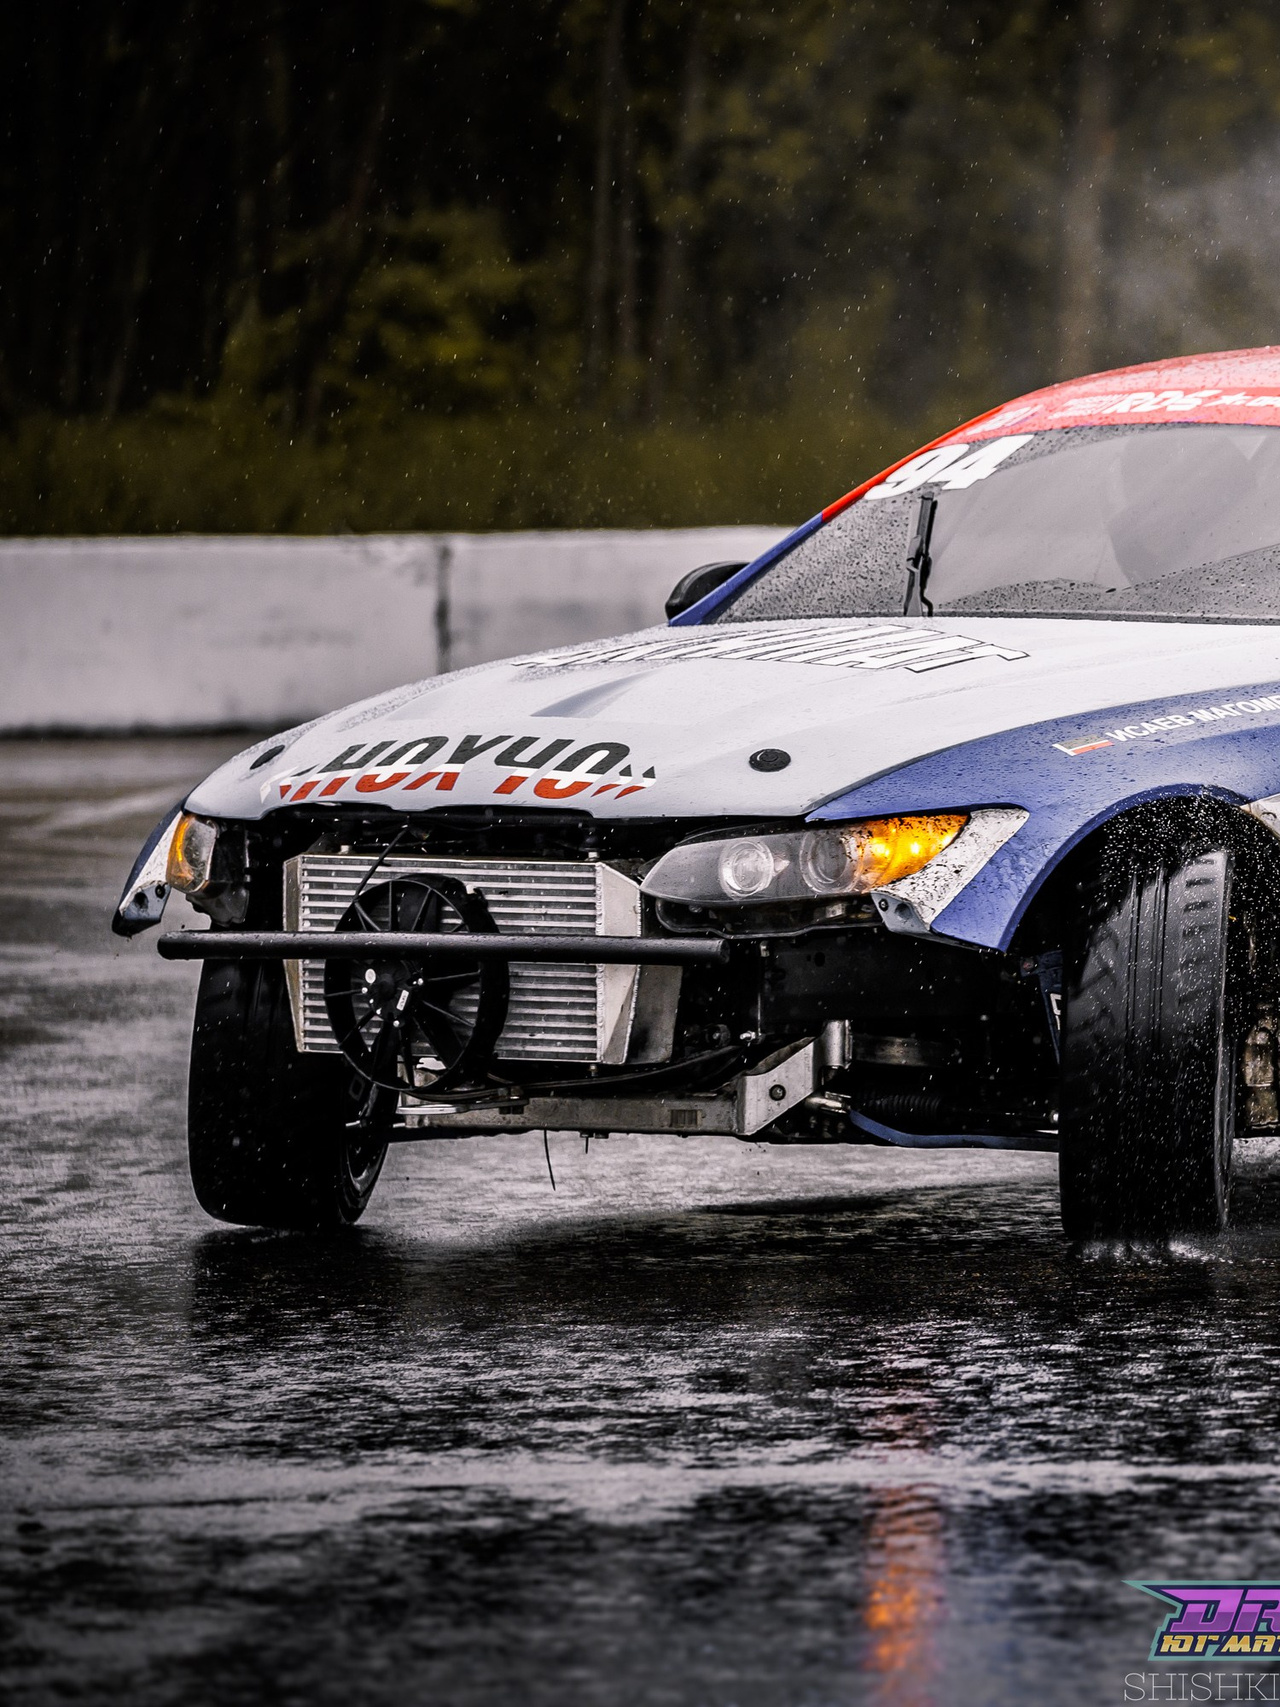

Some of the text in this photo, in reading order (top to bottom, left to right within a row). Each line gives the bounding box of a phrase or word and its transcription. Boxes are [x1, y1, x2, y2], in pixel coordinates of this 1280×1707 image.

[1103, 390, 1222, 414] RDS
[864, 434, 1035, 500] 94
[1105, 713, 1195, 742] ИСАЕВ
